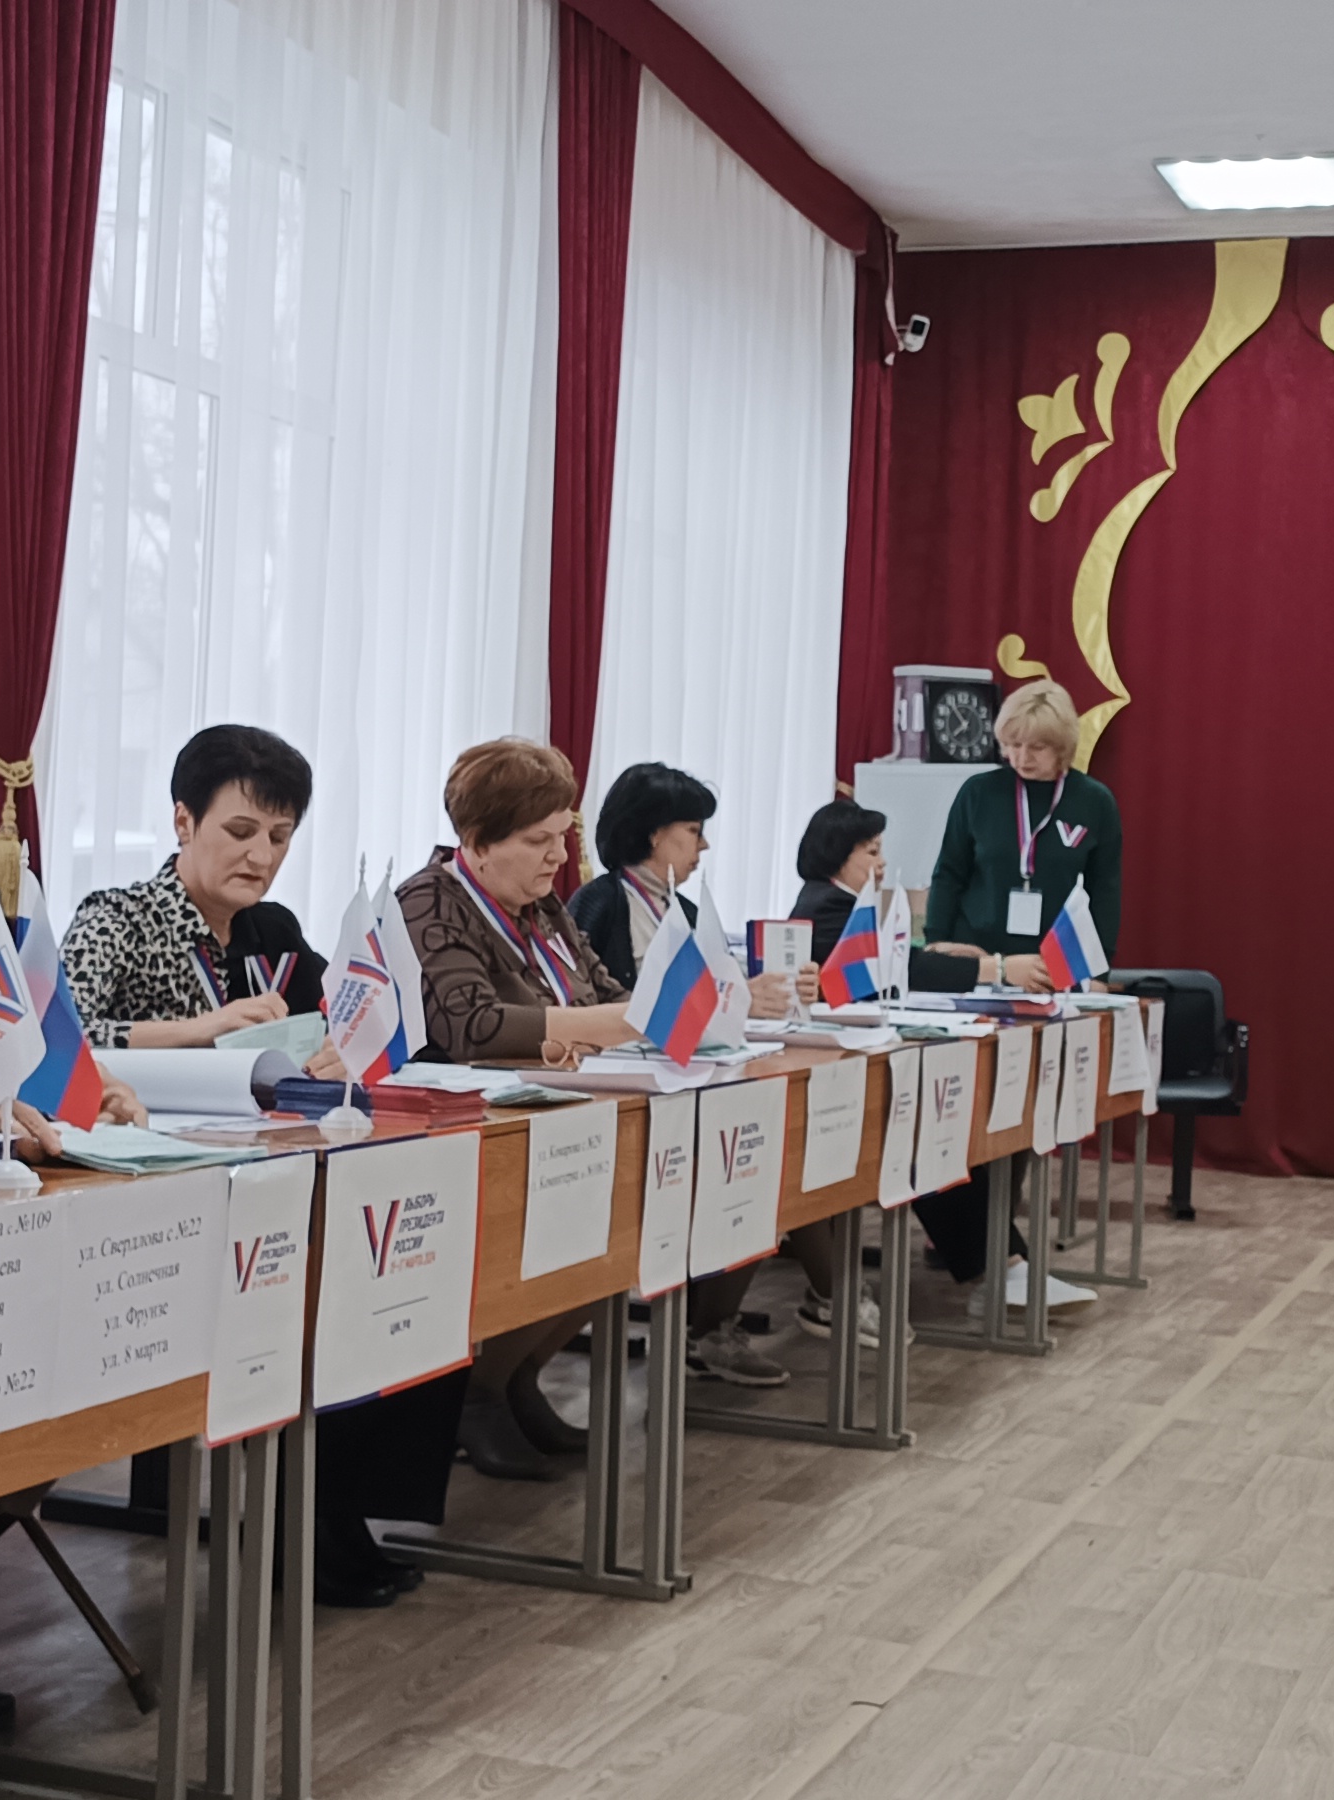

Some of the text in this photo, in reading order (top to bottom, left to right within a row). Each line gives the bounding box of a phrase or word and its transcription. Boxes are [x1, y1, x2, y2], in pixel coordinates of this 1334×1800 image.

[15, 1210, 52, 1234] №109
[100, 1229, 164, 1258] Свердлова
[175, 1216, 202, 1241] №22
[117, 1262, 180, 1291] Солнечная
[125, 1302, 169, 1329] Фрунзе
[124, 1345, 132, 1364] 8
[135, 1339, 169, 1362] марта
[4, 1368, 36, 1396] №22
